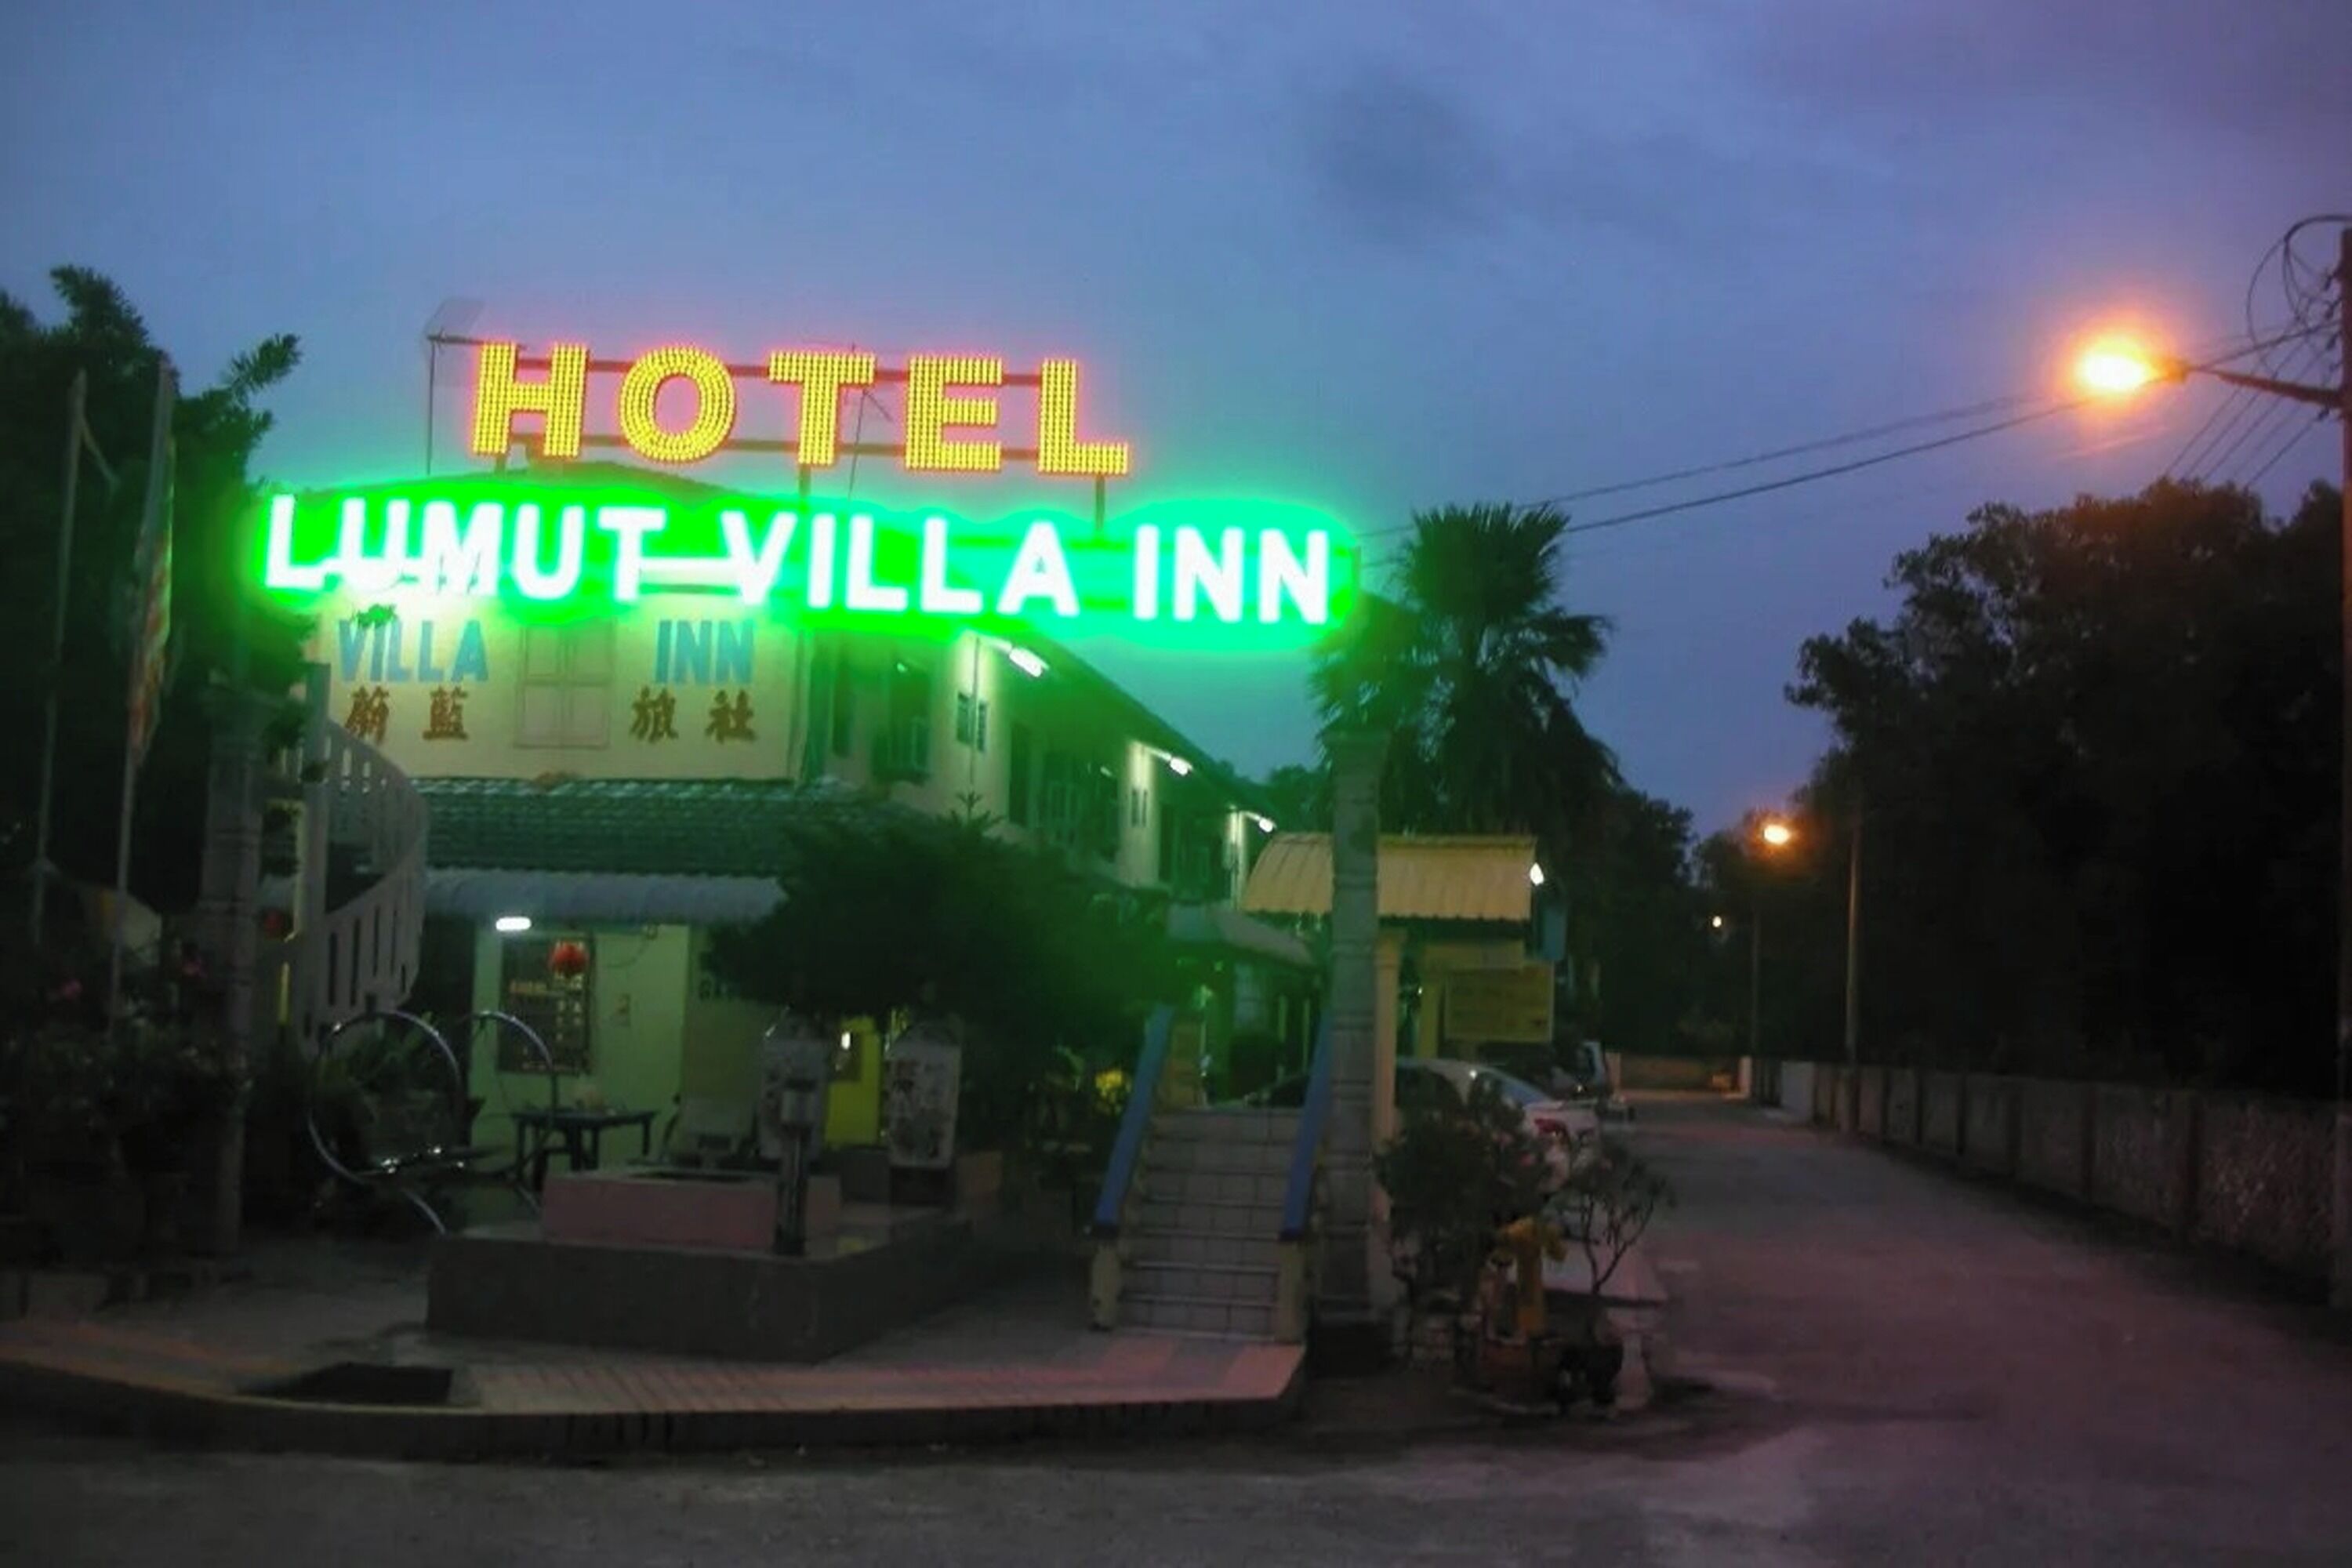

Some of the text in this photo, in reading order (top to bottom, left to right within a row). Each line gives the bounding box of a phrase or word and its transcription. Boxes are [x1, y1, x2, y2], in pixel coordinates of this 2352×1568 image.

[472, 342, 1129, 474] HOTEL
[265, 493, 1330, 624] LUMUT VILLA INN
[338, 619, 754, 686] VILLA INN
